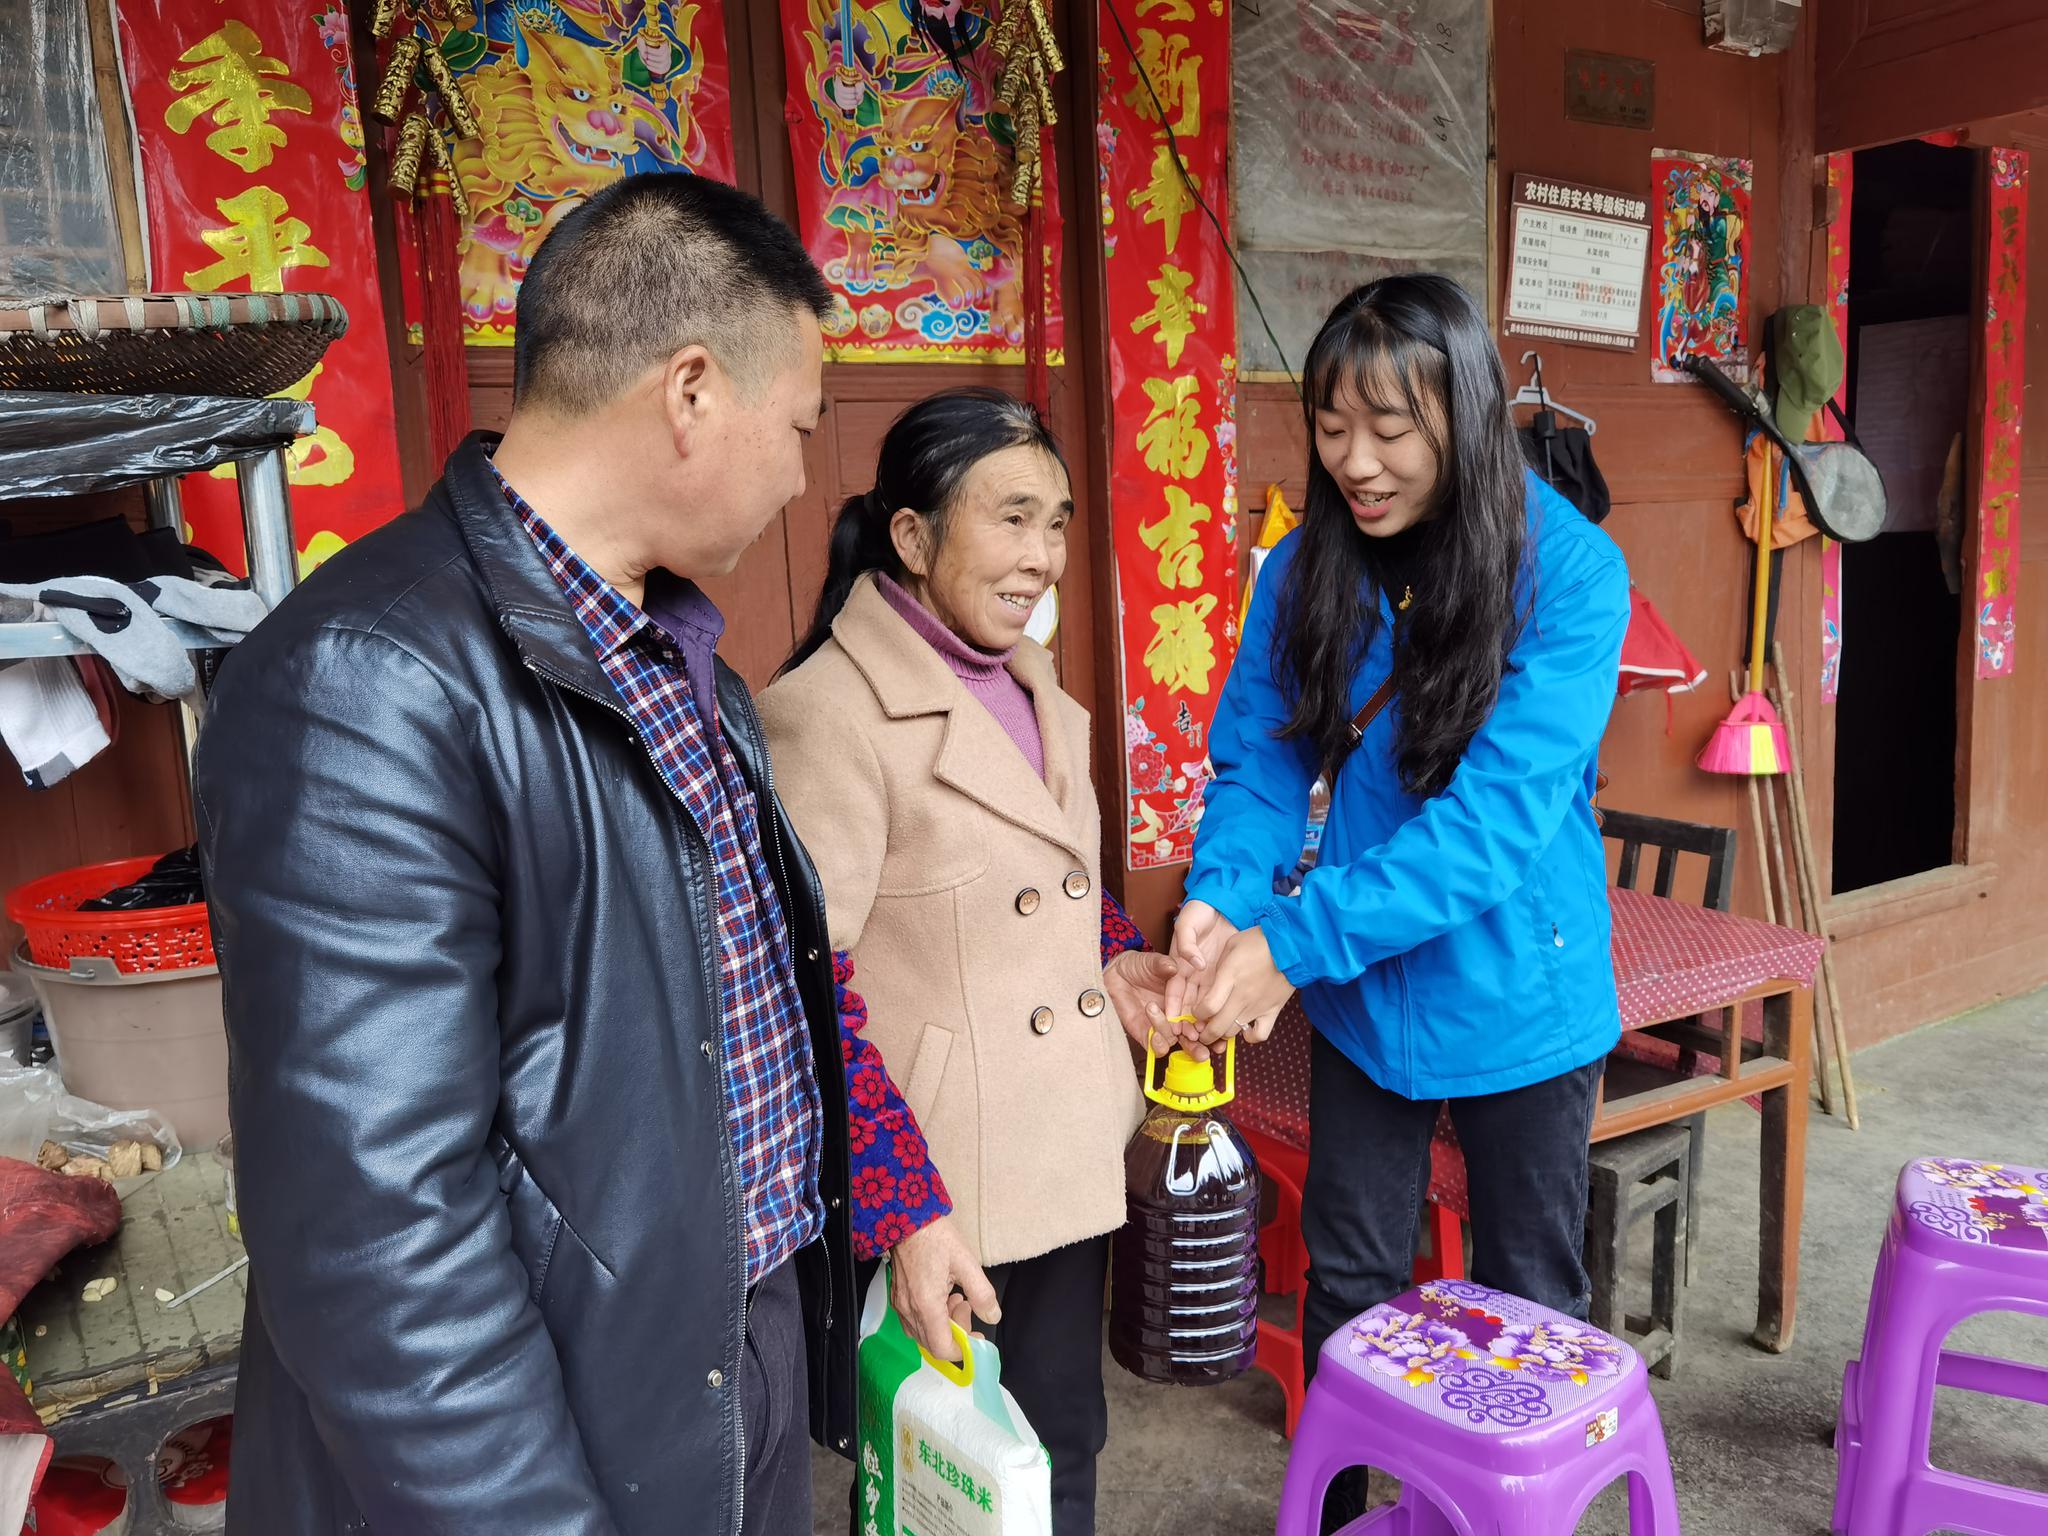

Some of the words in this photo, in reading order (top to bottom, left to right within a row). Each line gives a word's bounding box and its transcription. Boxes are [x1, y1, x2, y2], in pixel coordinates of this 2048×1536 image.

[1525, 181, 1646, 221] 农村住房安全等级标识牌
[1122, 0, 1218, 696] 新年幸福吉祥
[918, 1438, 993, 1514] 东北珍珠米
